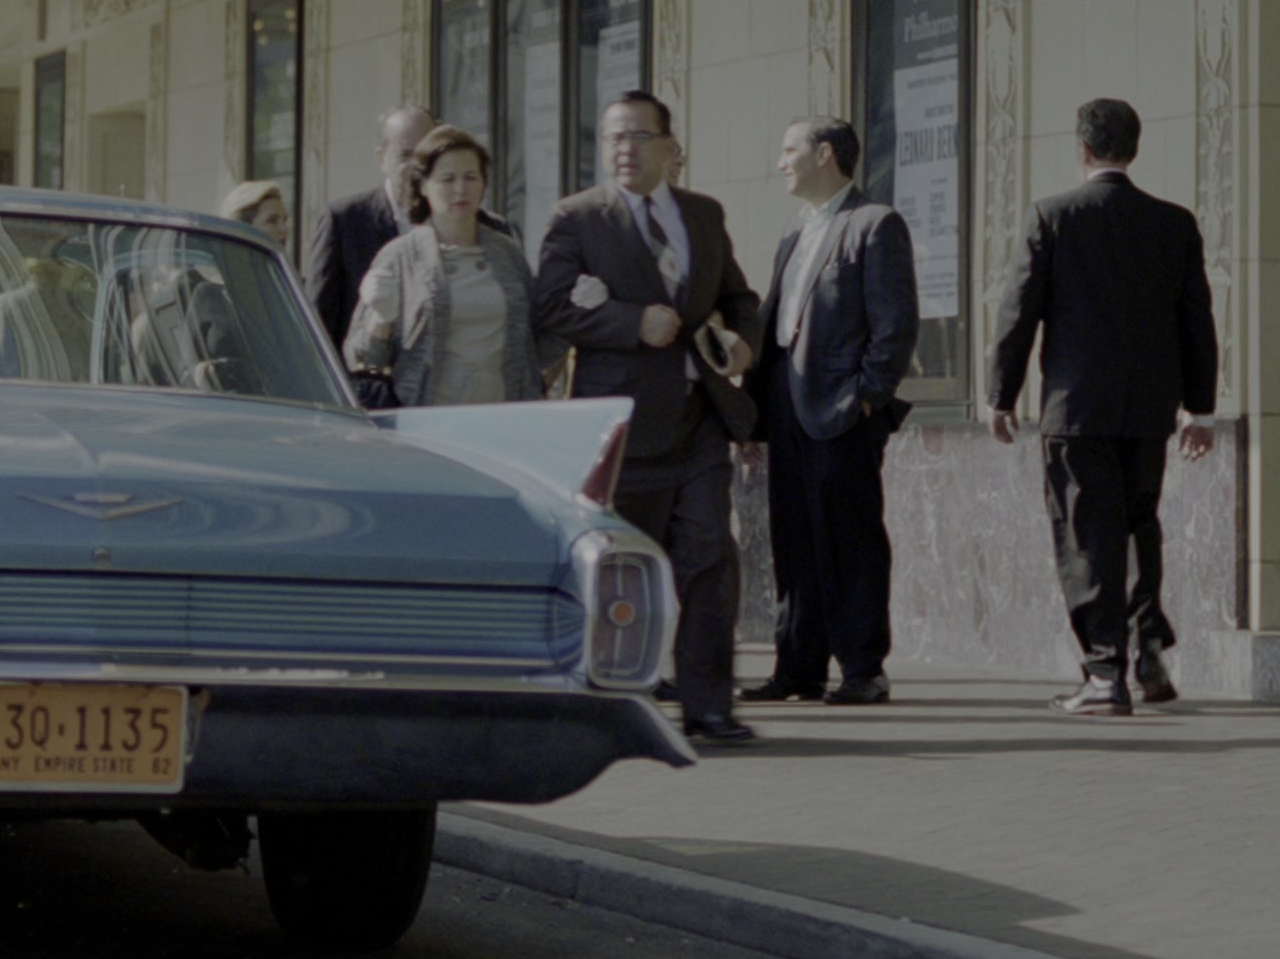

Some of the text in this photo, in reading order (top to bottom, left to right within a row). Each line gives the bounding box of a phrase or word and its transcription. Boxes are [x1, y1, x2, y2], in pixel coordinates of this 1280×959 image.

[0, 756, 20, 772] NY
[33, 756, 86, 773] EMPIRE
[91, 756, 134, 774] STATE
